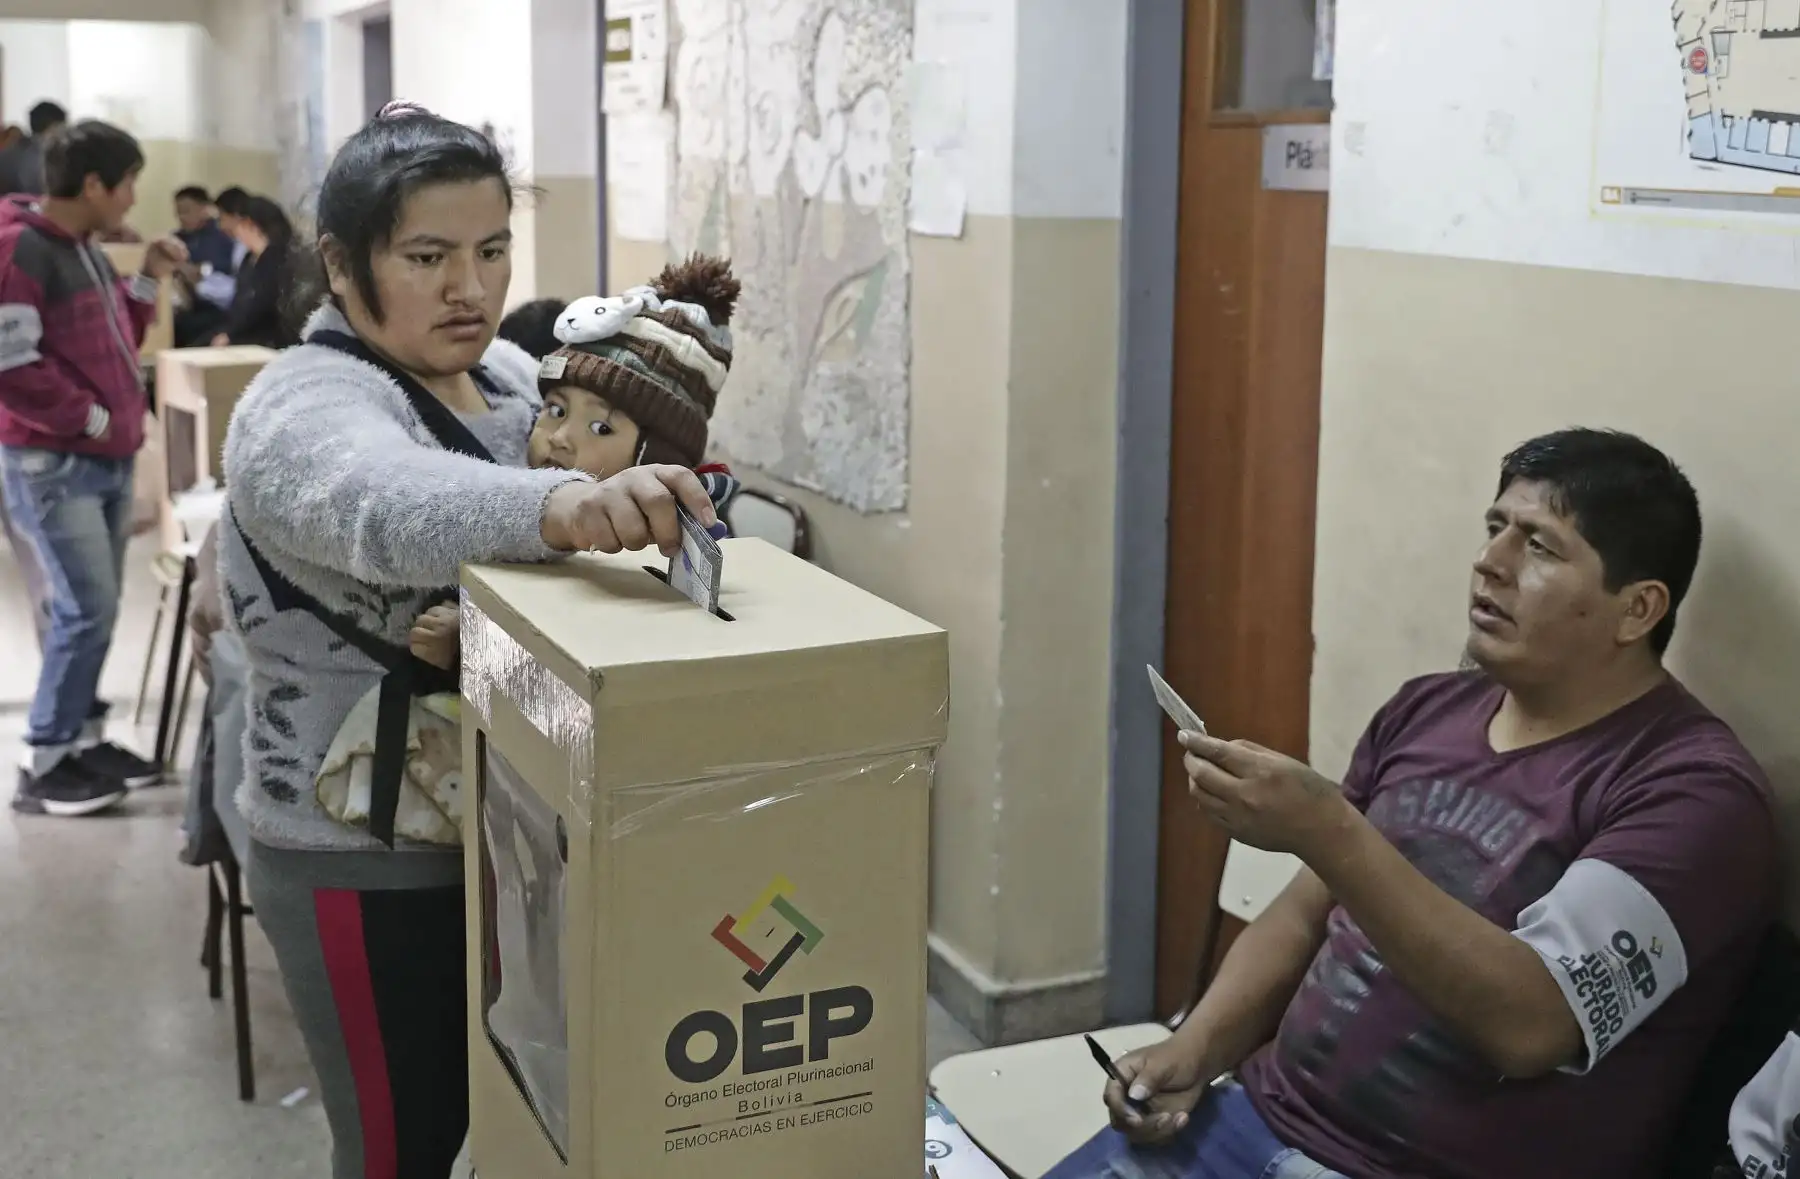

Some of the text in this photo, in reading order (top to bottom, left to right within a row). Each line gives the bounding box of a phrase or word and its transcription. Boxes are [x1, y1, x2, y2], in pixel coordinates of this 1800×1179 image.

[1285, 140, 1318, 170] Plá
[1611, 929, 1658, 999] OEP
[1580, 952, 1623, 1034] JURADO
[664, 985, 874, 1083] OEP
[664, 1057, 874, 1109] Órgano Electoral Plurinacional
[738, 1092, 803, 1113] Bolivia
[664, 1101, 873, 1152] DEMOCRACIAS EN EJERCICIO
